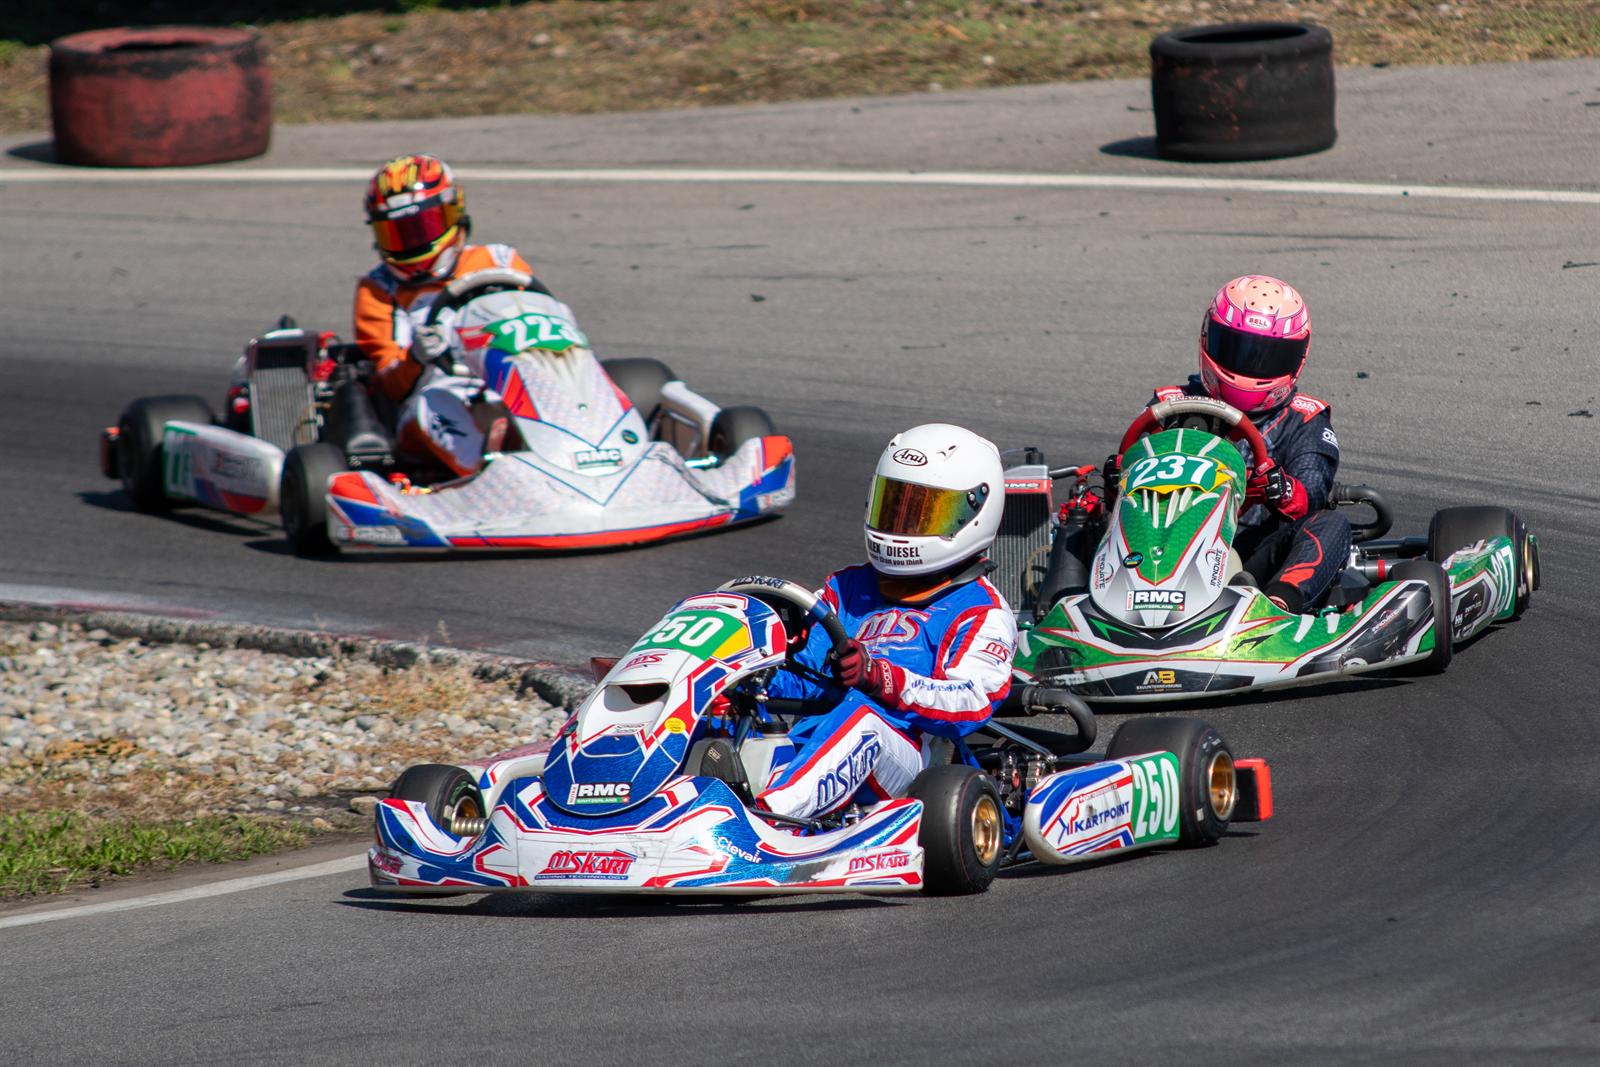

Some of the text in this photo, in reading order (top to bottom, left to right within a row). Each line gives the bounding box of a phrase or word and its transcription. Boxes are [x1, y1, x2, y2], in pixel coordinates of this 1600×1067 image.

[1248, 317, 1268, 327] BELL
[577, 450, 620, 463] RMC
[896, 450, 925, 463] Arai
[1132, 455, 1214, 488] 237
[1135, 591, 1184, 603] RMC
[1143, 670, 1176, 685] AB
[578, 783, 631, 797] RMC
[1134, 758, 1179, 838] 250
[1075, 801, 1130, 833] KARTPOINT
[719, 836, 762, 864] Clevair
